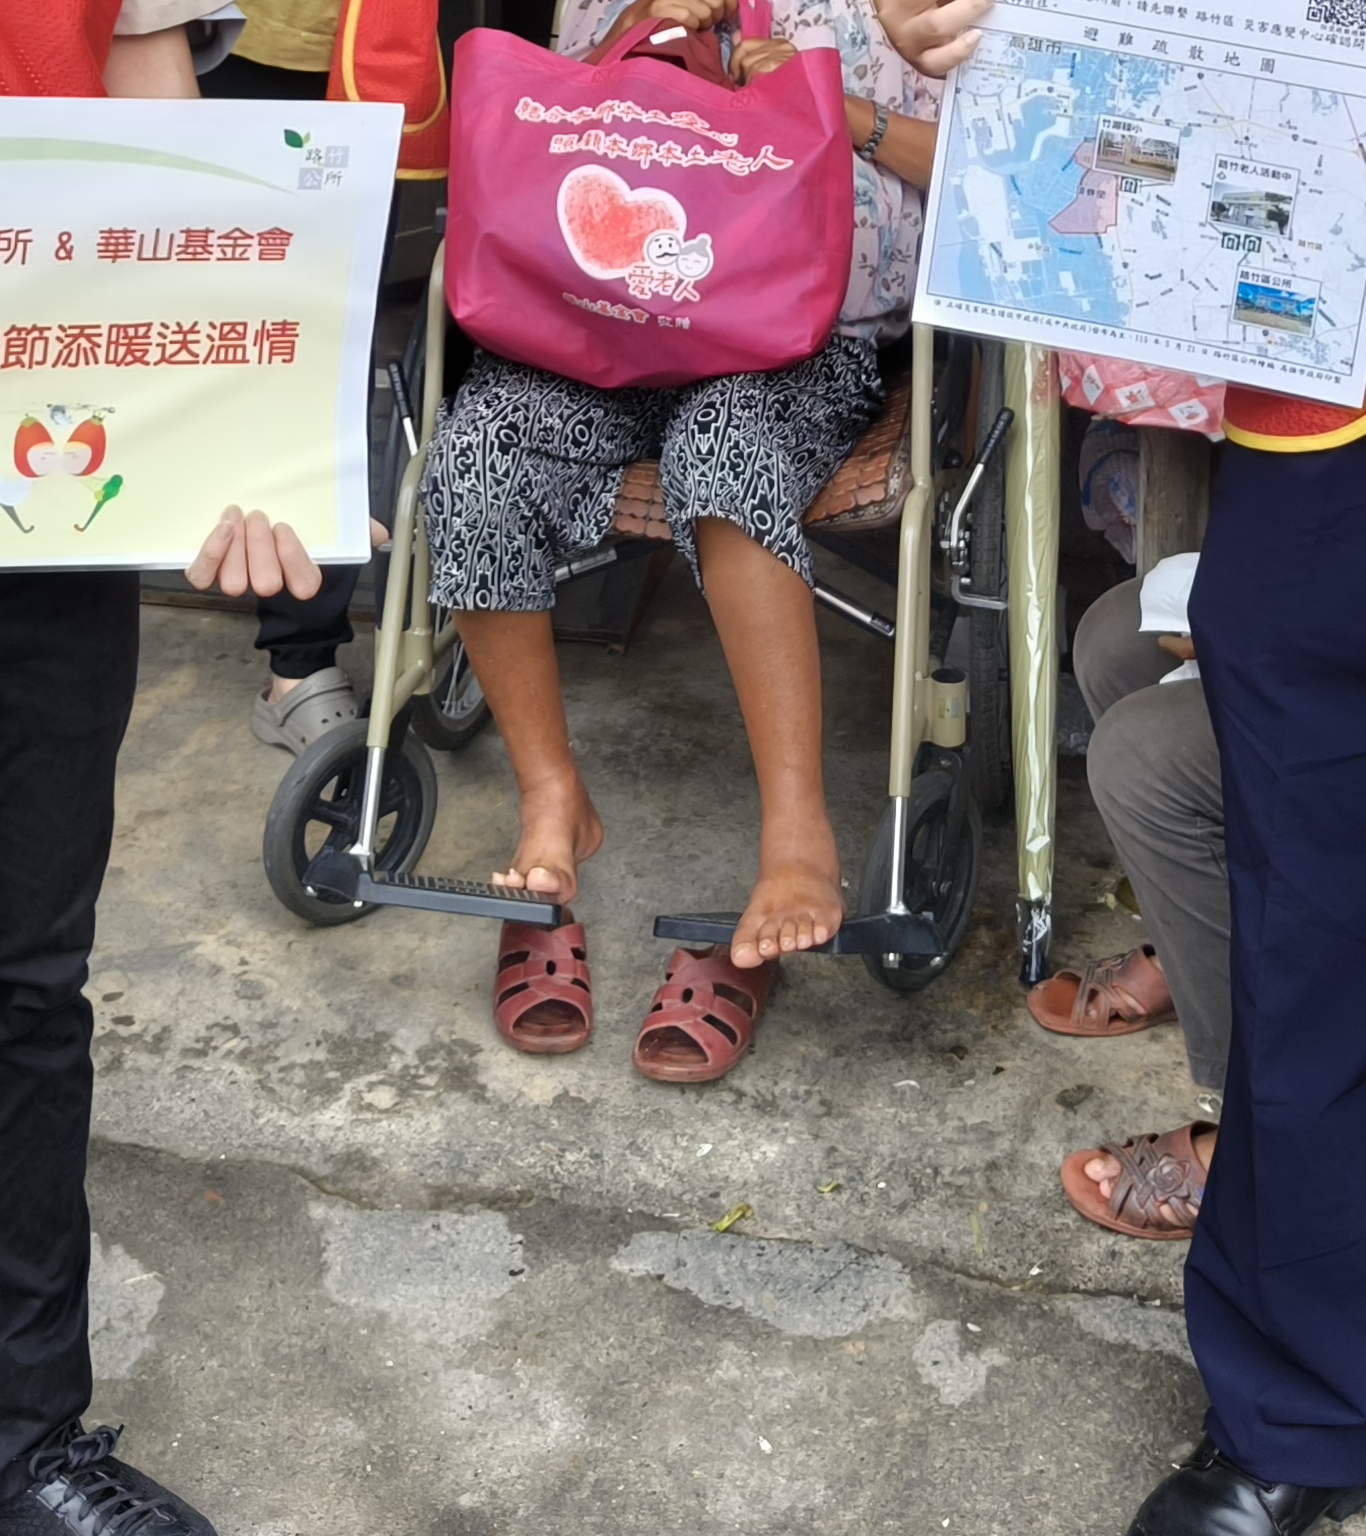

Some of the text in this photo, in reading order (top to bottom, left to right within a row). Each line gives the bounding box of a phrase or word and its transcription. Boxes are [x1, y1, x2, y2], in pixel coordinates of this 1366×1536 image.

[1195, 9, 1235, 28] 路竹區
[1008, 36, 1063, 56] 高雄市
[1083, 26, 1276, 74] 避難疏散地圖
[1216, 170, 1228, 182] 心
[1217, 158, 1293, 182] 路竹老人活動中
[53, 230, 76, 264] &
[95, 224, 295, 264] 華山基金會
[626, 263, 701, 302] 愛老人
[1238, 268, 1293, 290] 路竹區公所
